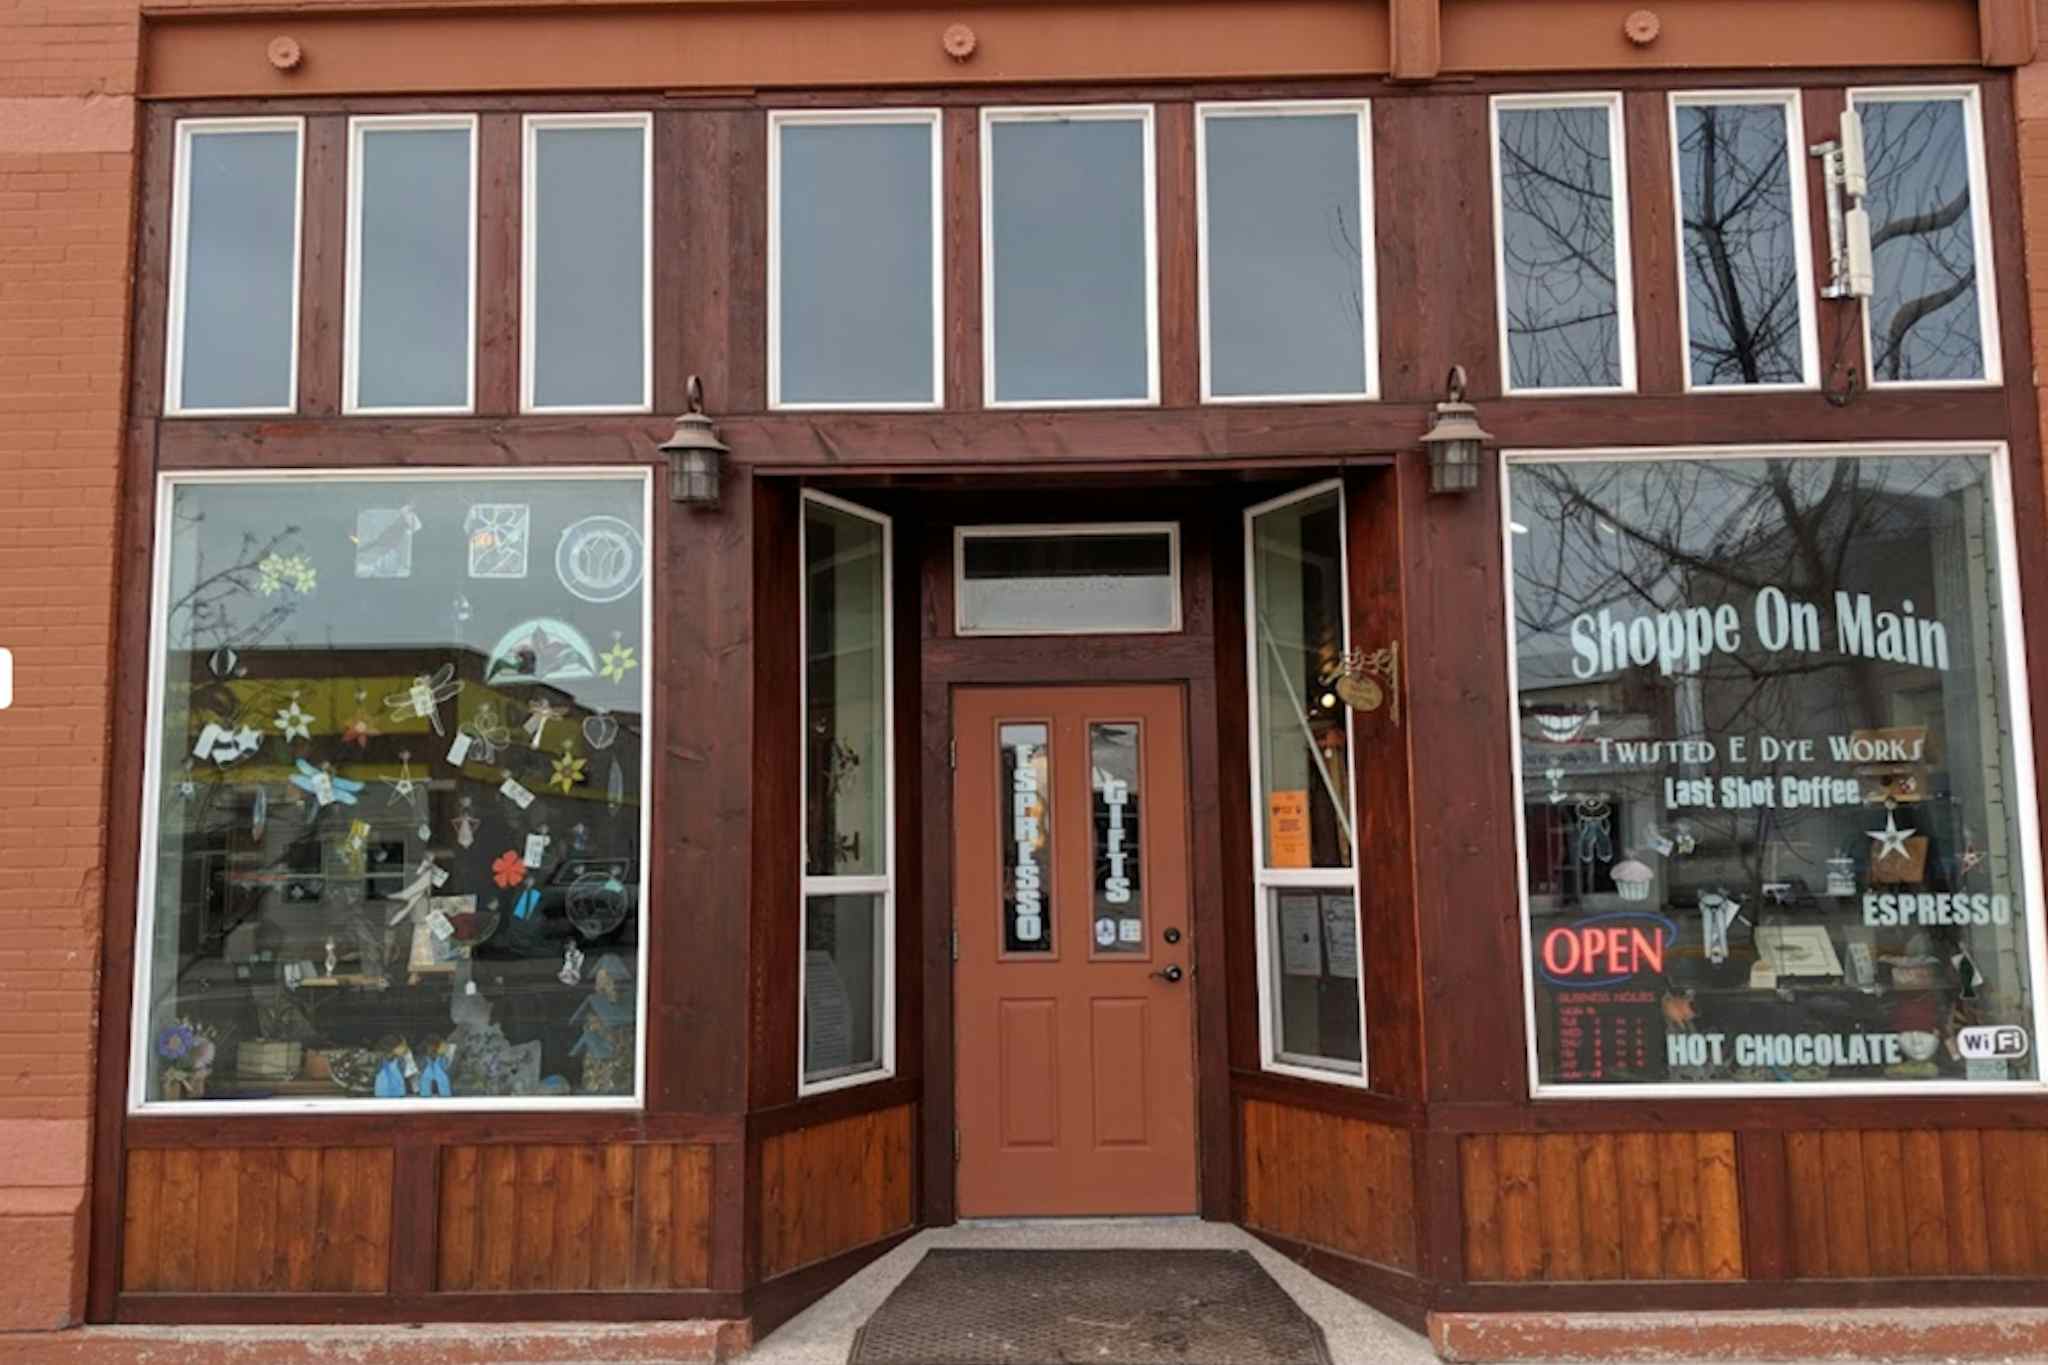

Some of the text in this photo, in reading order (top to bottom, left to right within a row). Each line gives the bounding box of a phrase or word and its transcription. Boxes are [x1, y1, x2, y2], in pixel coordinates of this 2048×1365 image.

[1570, 585, 1949, 679] Shoppe On Main
[1594, 736, 1924, 763] TWISTED E DYE WORKS
[1664, 776, 1861, 809] Last Shot Coffee
[1013, 744, 1042, 941] ESPRESSO
[1103, 779, 1131, 903] GIFTS
[1863, 893, 2011, 926] ESPRESSO
[1543, 927, 1663, 975] OPEN
[1666, 1033, 1725, 1066] HOT
[1735, 1033, 1902, 1066] CHOCOLATE
